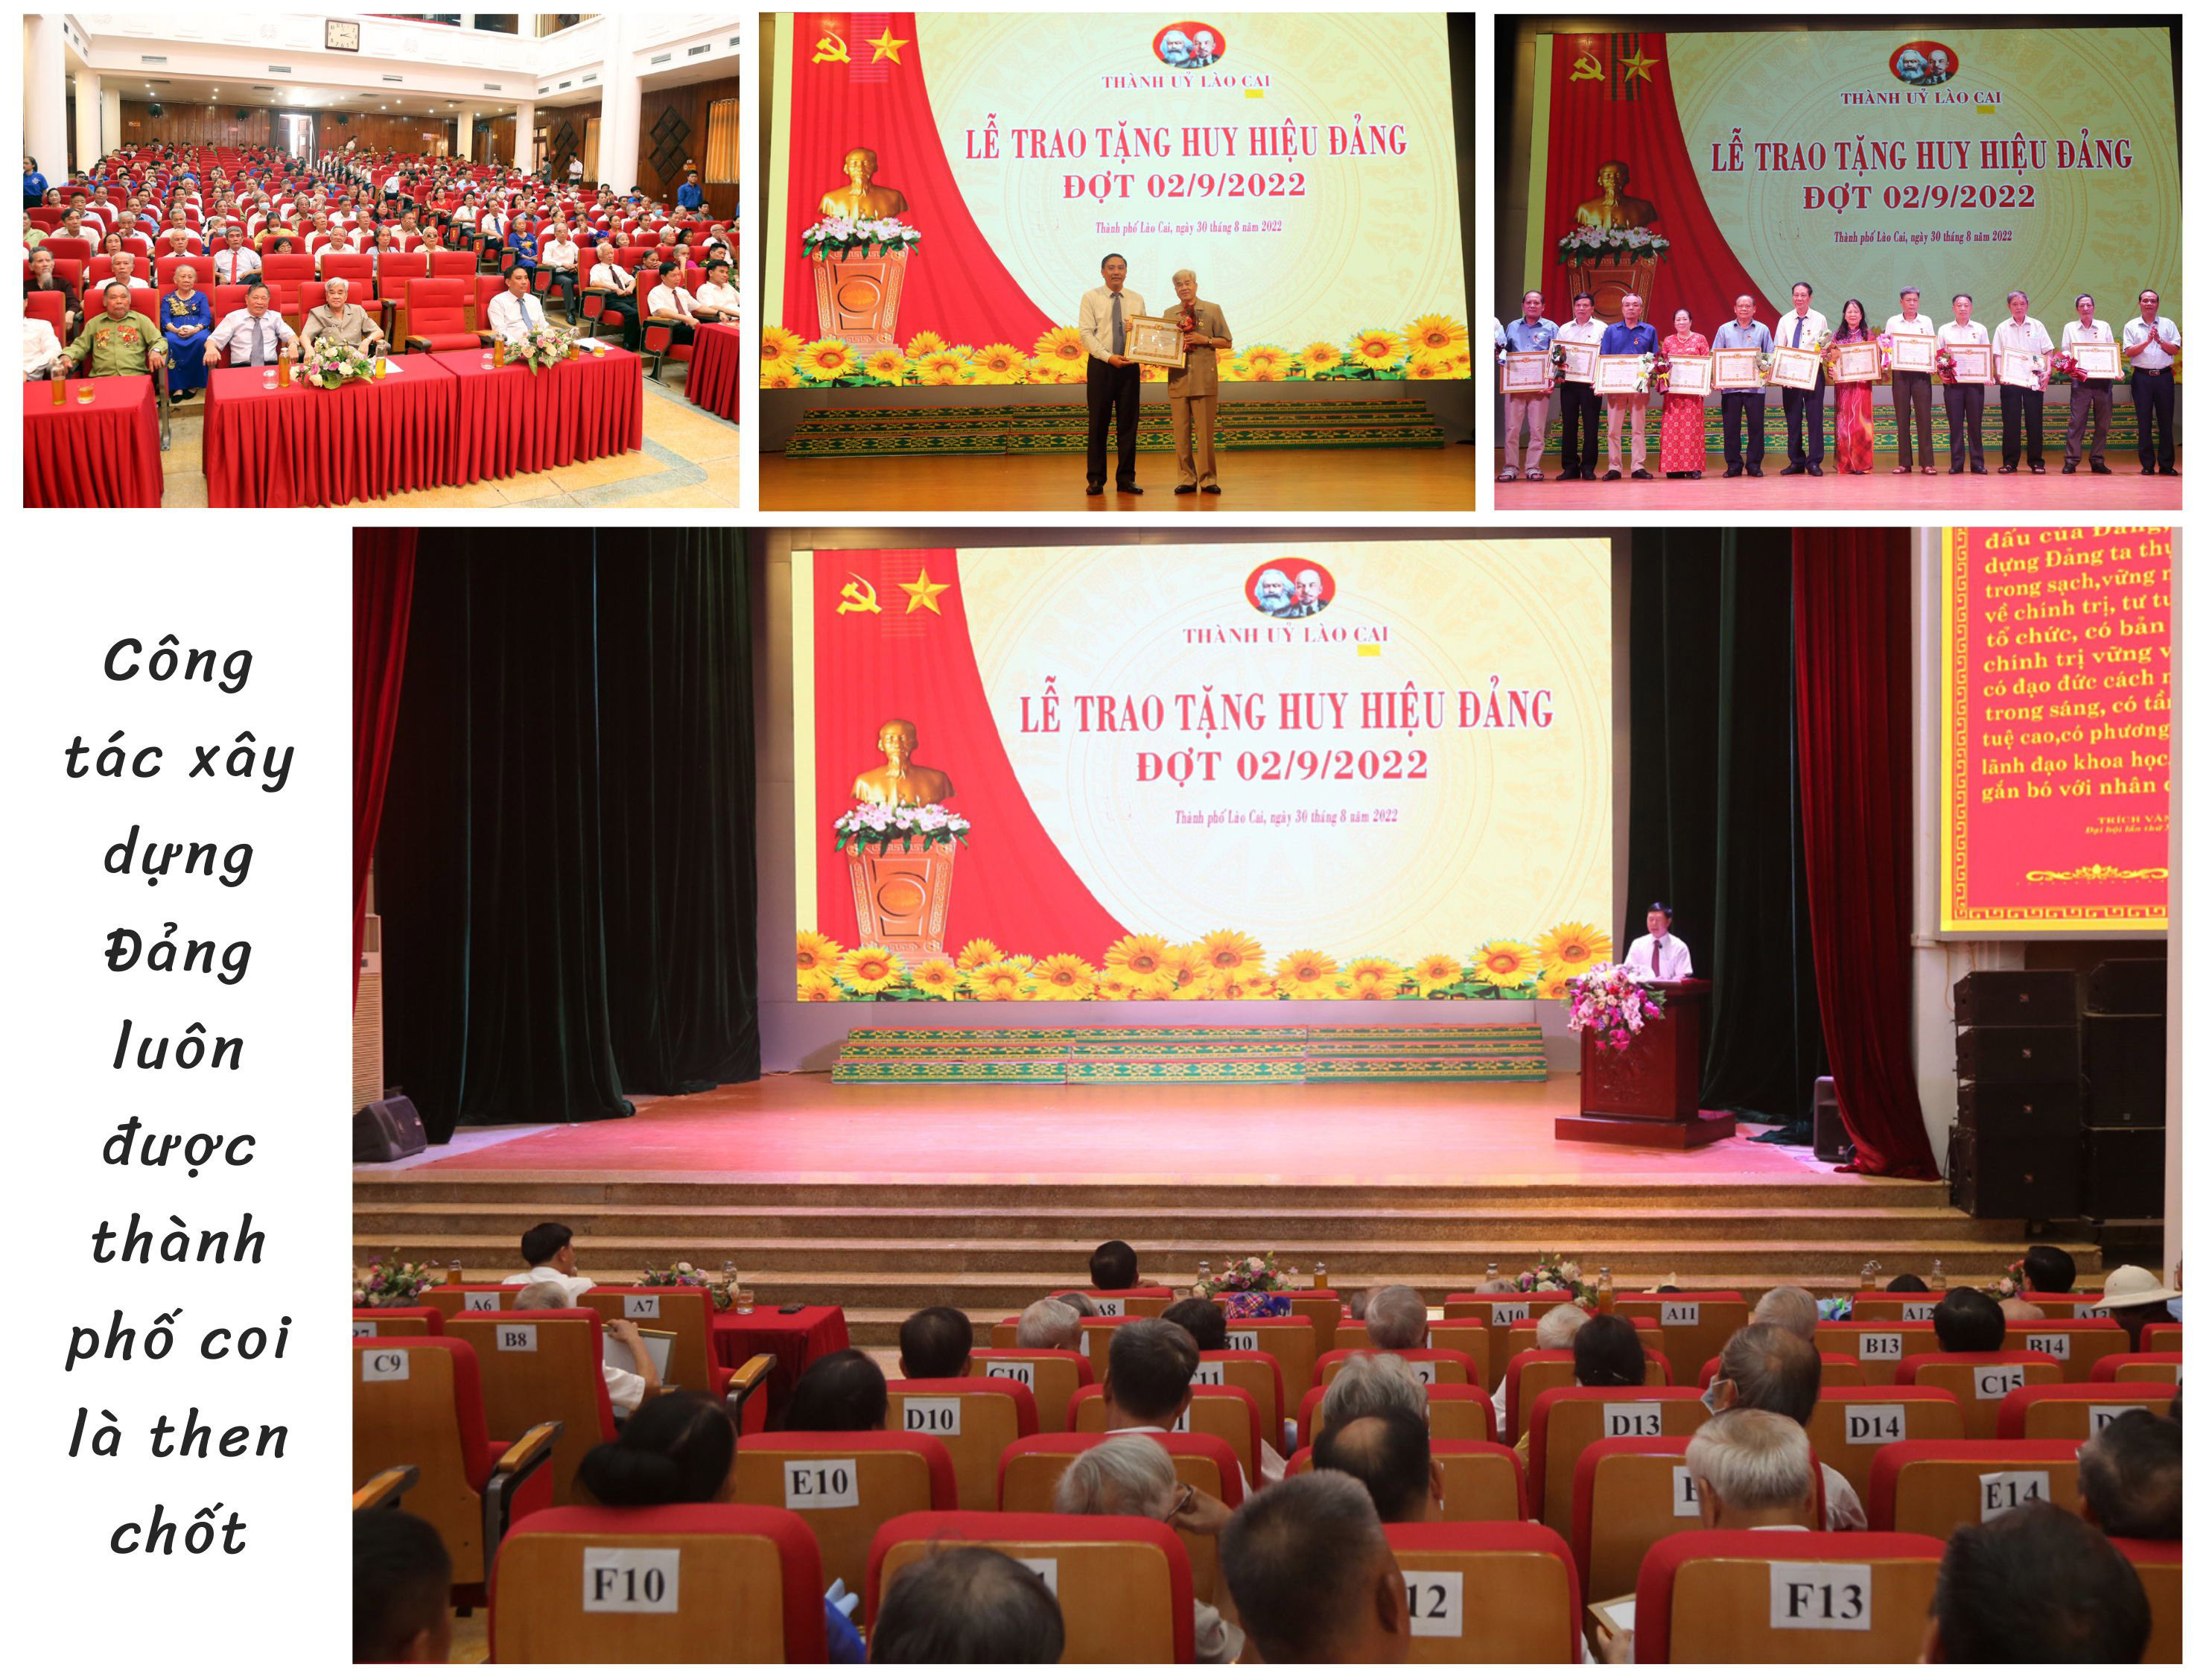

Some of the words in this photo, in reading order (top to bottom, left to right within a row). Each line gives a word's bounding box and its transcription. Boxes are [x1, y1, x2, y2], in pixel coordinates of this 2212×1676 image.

[1102, 74, 1164, 89] THÀNH
[1171, 71, 1192, 88] UỶ
[1201, 73, 1236, 88] LÀO
[1242, 74, 1271, 88] CAI
[1840, 90, 1901, 104] THÀNH
[1907, 87, 1927, 104] UỶ
[1935, 90, 1969, 104] LÀO
[1974, 91, 2002, 104] CAI
[966, 113, 999, 159] LỄ
[1011, 128, 1087, 159] TRAO
[1096, 121, 1171, 165] TẶNG
[1182, 125, 1238, 156] HUY
[1249, 117, 1318, 163] HIỆU
[1329, 113, 1407, 156] ĐẢNG
[1712, 128, 1744, 172] LỄ
[1755, 142, 1826, 171] TRAO
[1834, 136, 1907, 176] TẶNG
[1916, 141, 1971, 169] HUY
[1980, 133, 2047, 176] HIỆU
[2057, 129, 2133, 169] ĐẢNG
[1064, 171, 1134, 203] ĐỢT
[1148, 172, 1306, 198] 02/9/2022
[1803, 183, 1872, 214] ĐỢT
[1883, 185, 2035, 209] 02/9/2022
[1096, 221, 1120, 234] Thành
[1123, 220, 1139, 236] phố
[1140, 221, 1155, 233] Lào
[1158, 221, 1173, 235] Cai,
[1175, 222, 1194, 235] ngày
[1197, 220, 1207, 232] 30
[1210, 220, 1232, 235] tháng
[1234, 220, 1239, 232] 8
[1242, 222, 1259, 232] năm
[1262, 220, 1282, 232] 2022
[1834, 231, 1857, 243] Thành
[1860, 229, 1876, 245] phố
[1877, 231, 1891, 242] Lào
[1894, 231, 1907, 244] Cai,
[1910, 232, 1927, 244] ngày
[1930, 231, 1941, 242] 30
[1943, 230, 1964, 244] tháng
[1966, 231, 1971, 241] 8
[1974, 232, 1990, 241] năm
[1992, 230, 2012, 241] 2022
[1985, 556, 2040, 577] dựng
[2046, 547, 2104, 567] Đảng
[2110, 547, 2132, 560] ta
[1986, 581, 2041, 598] trong
[1986, 603, 2008, 623] về
[2014, 600, 2074, 620] chính
[2082, 596, 2116, 617] trị,
[2122, 594, 2146, 610] tư
[1183, 625, 1259, 644] THÀNH
[1268, 621, 1294, 643] UỶ
[1303, 623, 1347, 643] LÀO
[1353, 626, 1389, 643] CAI
[1987, 626, 2010, 647] tổ
[2015, 626, 2078, 645] chức,
[2085, 621, 2112, 639] có
[2120, 616, 2164, 635] bản
[1984, 652, 2048, 673] chính
[2056, 648, 2084, 670] trị
[2092, 645, 2152, 664] vững
[1983, 679, 2006, 697] có
[2104, 669, 2154, 689] cách
[1020, 675, 1061, 733] LỄ
[1074, 694, 1165, 732] TRAO
[1175, 685, 1266, 739] TẶNG
[1279, 691, 1350, 730] HUY
[1360, 681, 1445, 737] HIỆU
[1458, 676, 1554, 729] ĐẢNG
[1986, 705, 2044, 721] trong
[2050, 700, 2105, 719] sáng,
[2112, 694, 2138, 714] có
[1983, 729, 2014, 750] tuệ
[2090, 723, 2170, 744] phương
[1136, 747, 1222, 787] ĐỢT
[1236, 749, 1428, 781] 02/9/2022
[1982, 756, 2025, 775] lãnh
[2074, 752, 2123, 770] khoa
[1982, 779, 2019, 803] gắn
[2027, 781, 2052, 798] bó
[2059, 779, 2091, 797] với
[2100, 776, 2156, 796] nhân
[1175, 810, 1204, 824] Thành
[1207, 808, 1226, 828] phố
[1228, 810, 1245, 824] Lào
[1249, 809, 1267, 825] Cai,
[1271, 812, 1291, 827] ngày
[1295, 809, 1308, 823] 30
[1311, 809, 1337, 825] tháng
[1340, 809, 1346, 822] 8
[1350, 811, 1370, 822] năm
[1373, 809, 1398, 823] 2022
[472, 1299, 492, 1311] A6
[634, 1299, 654, 1312] A7
[1667, 1308, 1697, 1320] A11
[1494, 1310, 1524, 1324] A10
[505, 1333, 527, 1347] B8
[1866, 1338, 1898, 1353] B13
[2029, 1339, 2064, 1353] B14
[375, 1355, 401, 1372] C9
[1981, 1375, 2024, 1394] C15
[906, 1408, 954, 1431] D10
[1612, 1415, 1660, 1435] D13
[1850, 1416, 1900, 1438] D14
[792, 1469, 848, 1495] E10
[1987, 1482, 2039, 1510] E14
[592, 1567, 665, 1603] F10
[1407, 1584, 1447, 1619] 12
[1787, 1583, 1864, 1619] F13
